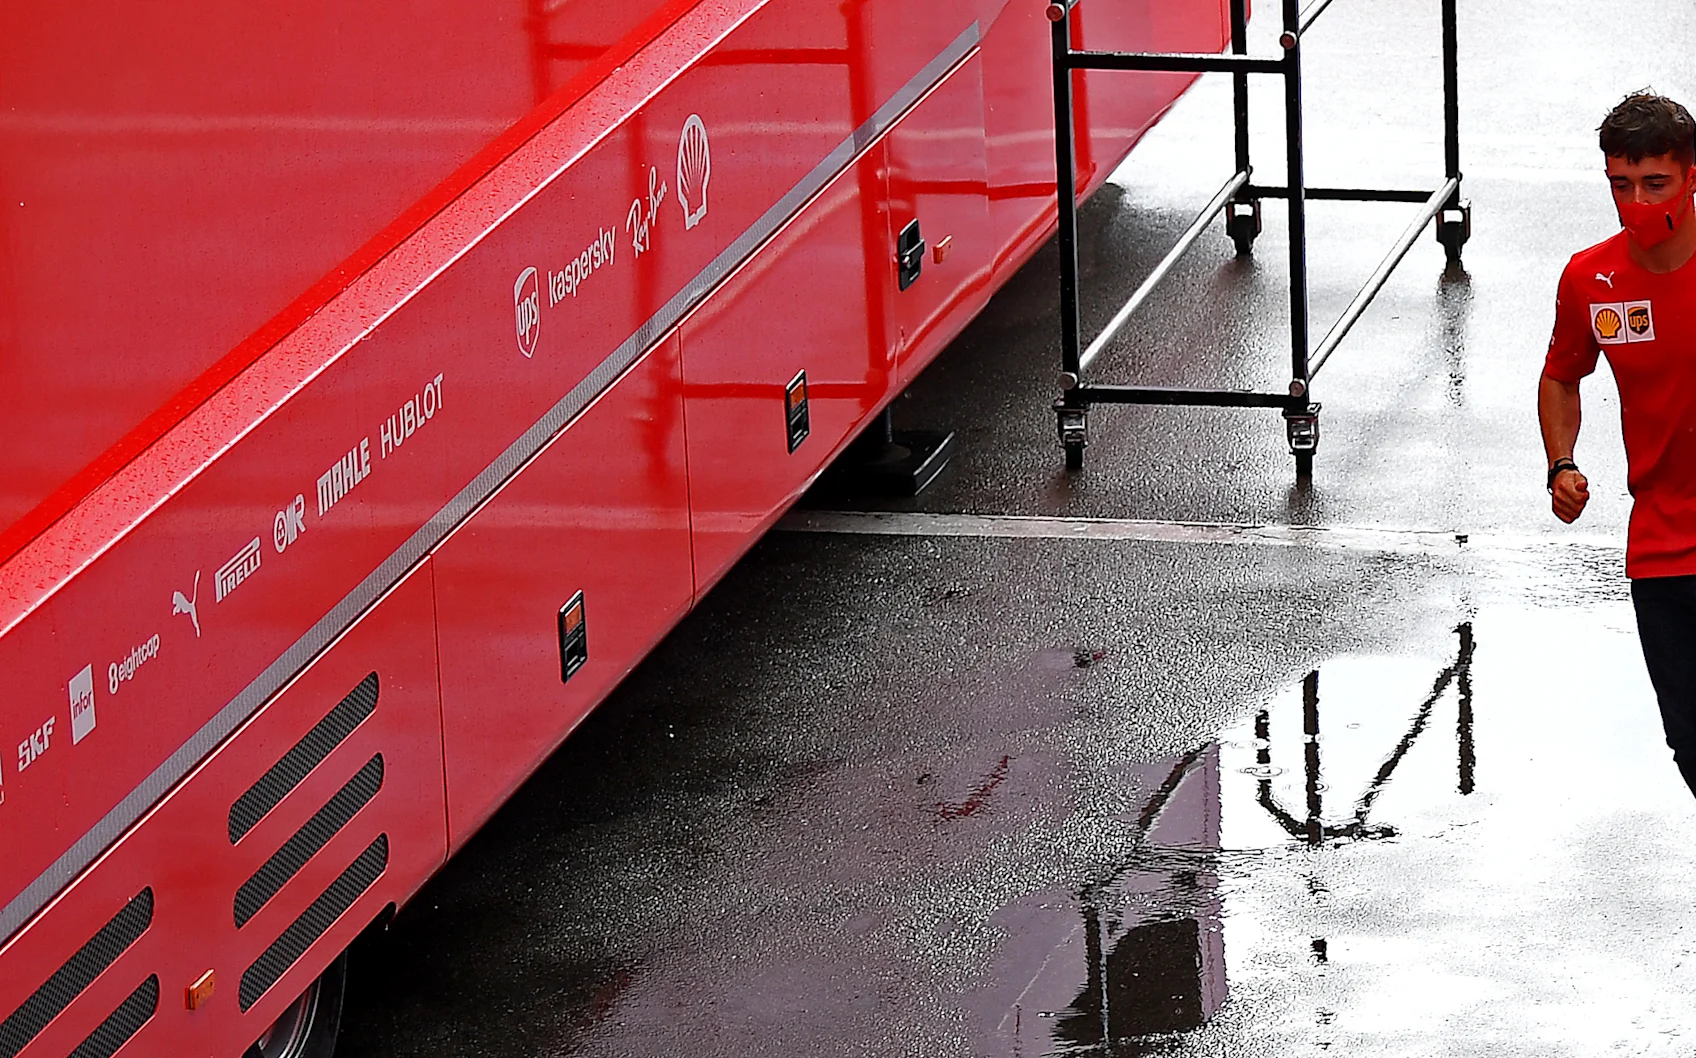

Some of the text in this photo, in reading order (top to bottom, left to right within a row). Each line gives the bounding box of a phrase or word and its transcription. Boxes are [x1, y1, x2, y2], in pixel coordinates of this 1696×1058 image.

[548, 226, 616, 308] kaspersky
[516, 291, 539, 345] ups
[1629, 314, 1649, 332] ups
[380, 372, 444, 459] HUBLOT
[317, 437, 371, 517] MAHLE
[214, 536, 262, 603] PIRELLI
[72, 690, 93, 720] infor
[18, 716, 56, 773] SKF
